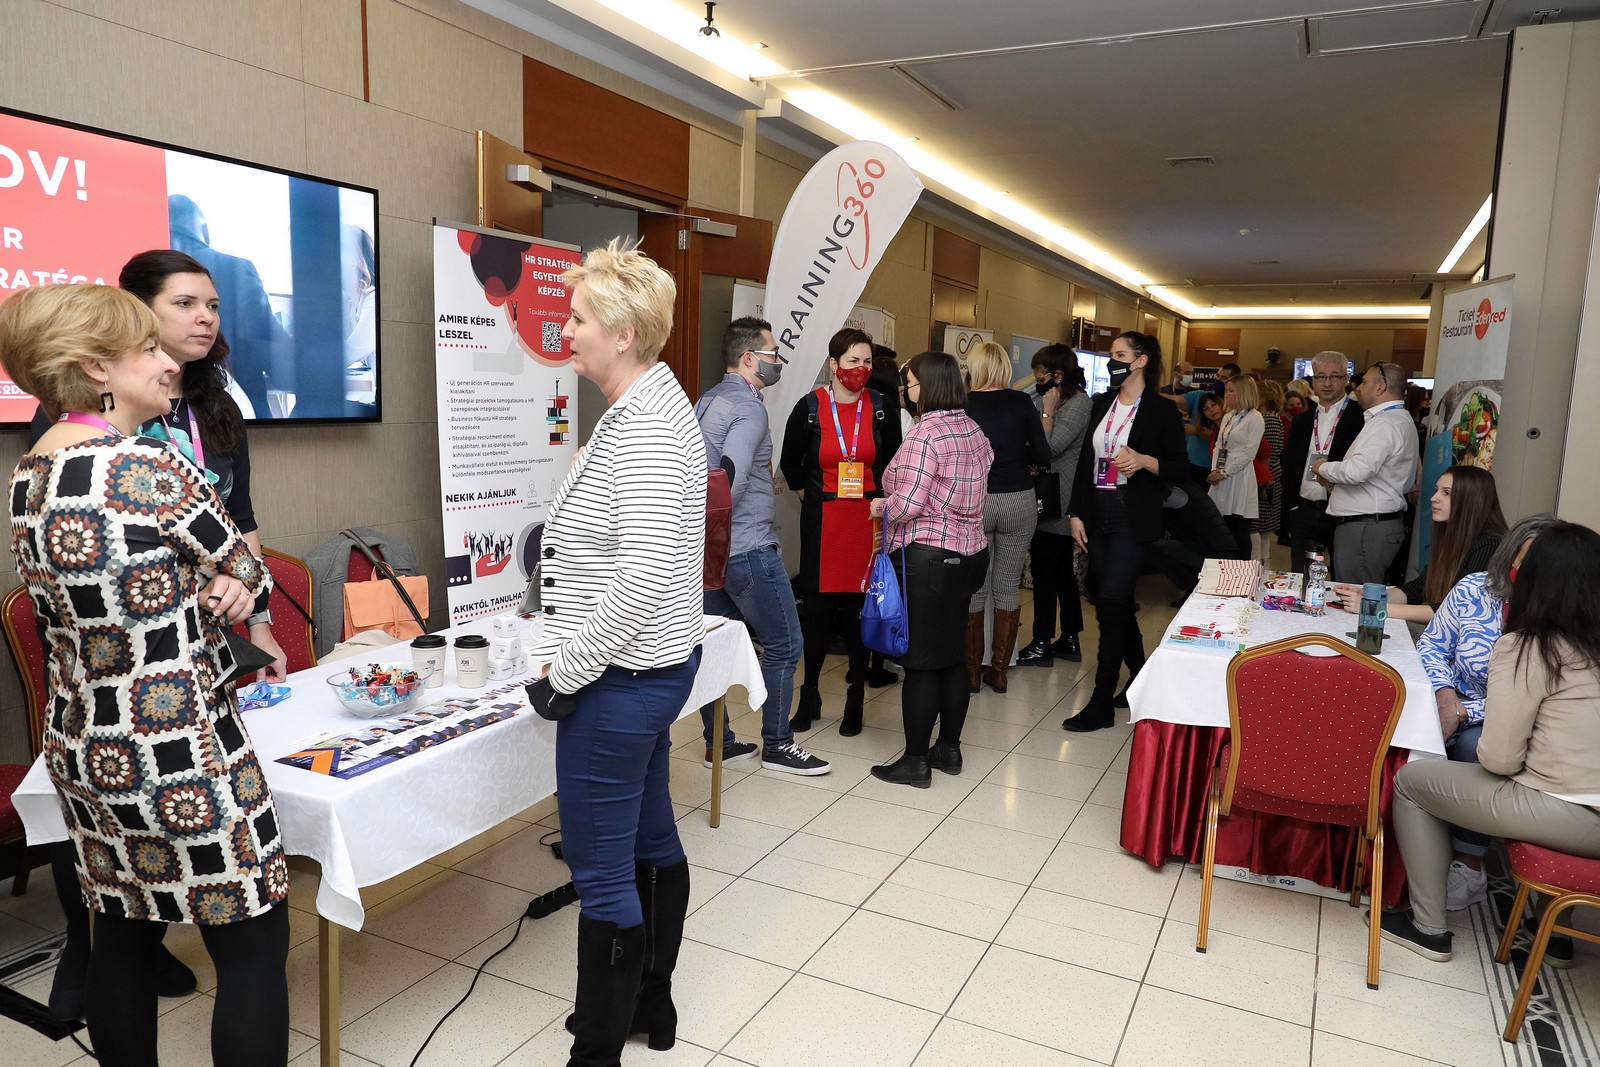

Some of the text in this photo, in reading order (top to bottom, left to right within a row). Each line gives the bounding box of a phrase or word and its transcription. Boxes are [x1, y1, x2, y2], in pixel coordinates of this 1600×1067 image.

[525, 254, 536, 264] HR
[537, 285, 565, 297] KÉPZÉS
[529, 308, 547, 316] További
[1459, 307, 1506, 325] Ticket Edenred
[439, 314, 496, 327] AMIRE KÉPES
[439, 329, 473, 340] LESZEL
[1442, 323, 1473, 338] Restaurant
[446, 488, 517, 503] NEKIK AJÁNLJUK
[453, 599, 489, 614] AKIKTŐL
[1280, 878, 1295, 886] GQS
